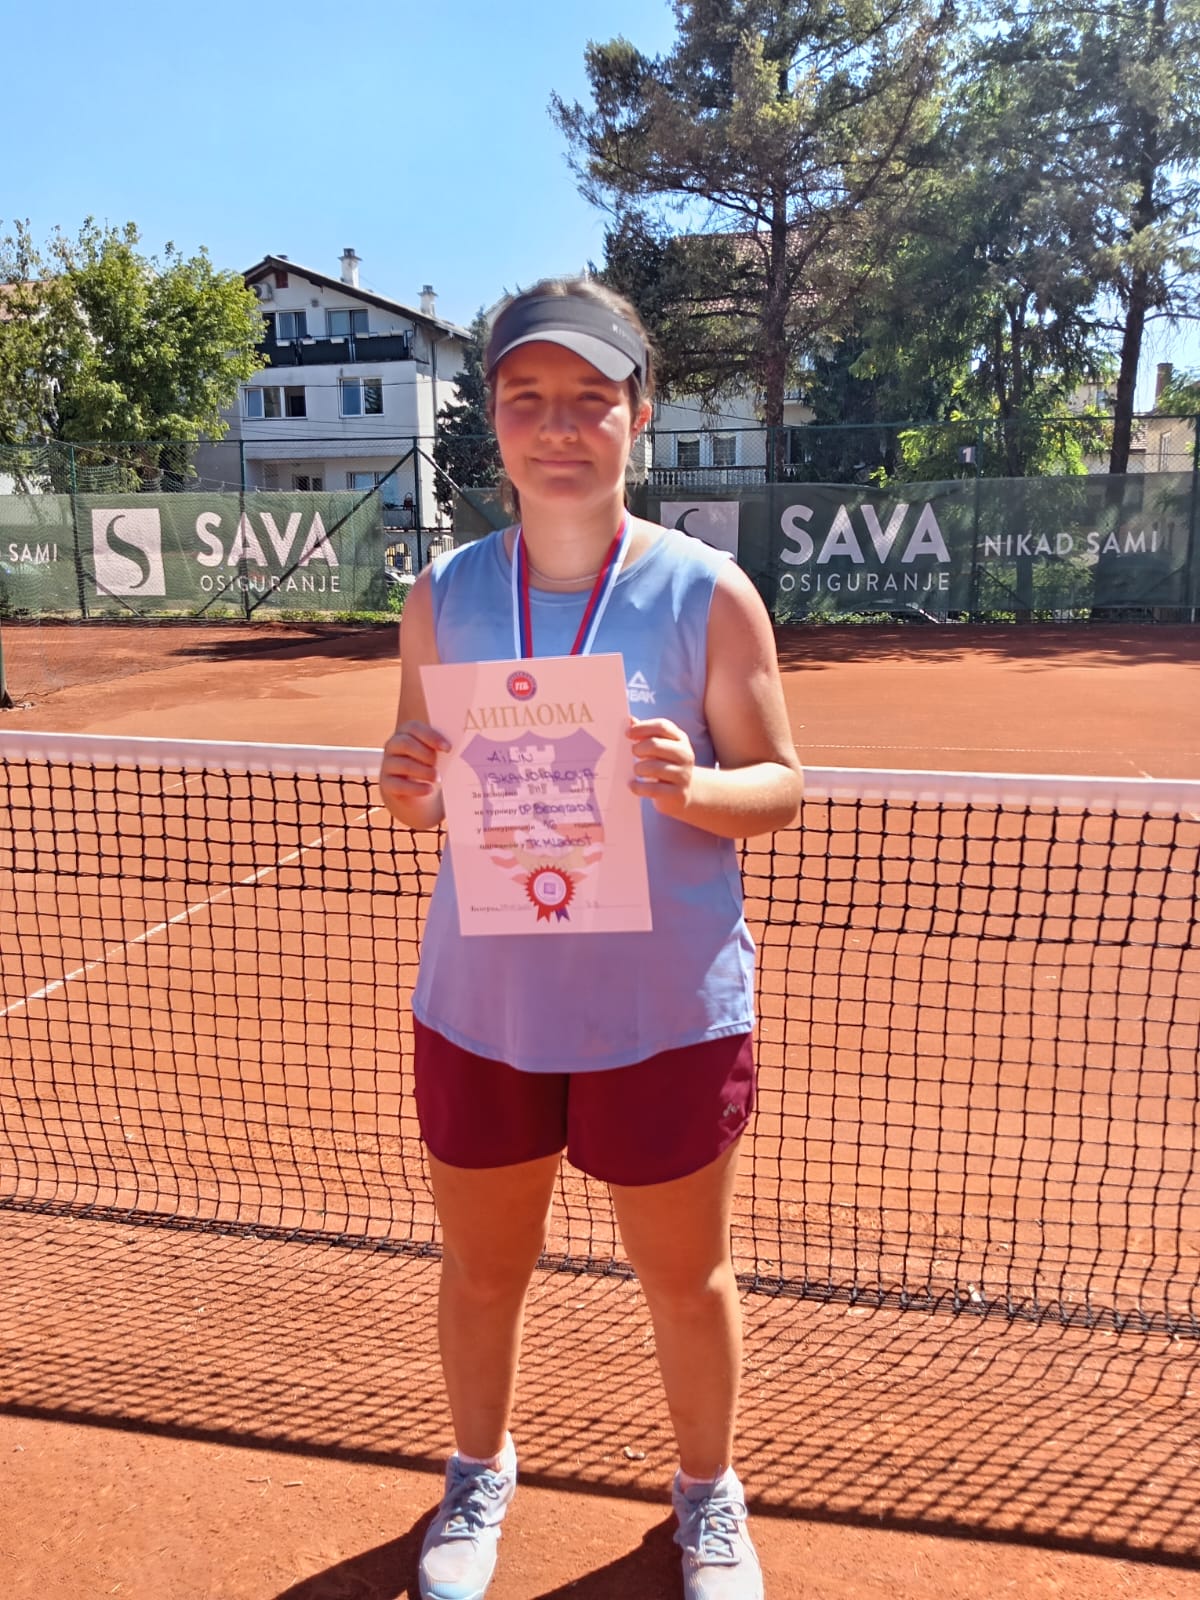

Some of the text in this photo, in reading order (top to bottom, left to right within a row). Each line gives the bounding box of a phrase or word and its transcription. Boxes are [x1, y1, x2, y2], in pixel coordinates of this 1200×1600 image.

[963, 447, 971, 463] 1
[195, 511, 340, 567] SAVA
[780, 502, 951, 565] SAVA
[984, 530, 1158, 556] NIKAD SAMI
[9, 543, 57, 563] SAMI
[200, 575, 341, 593] OSIGURANJE
[780, 572, 950, 593] OSIGURANJE
[626, 688, 656, 704] EAK
[463, 702, 595, 733] ДИПЛОМА
